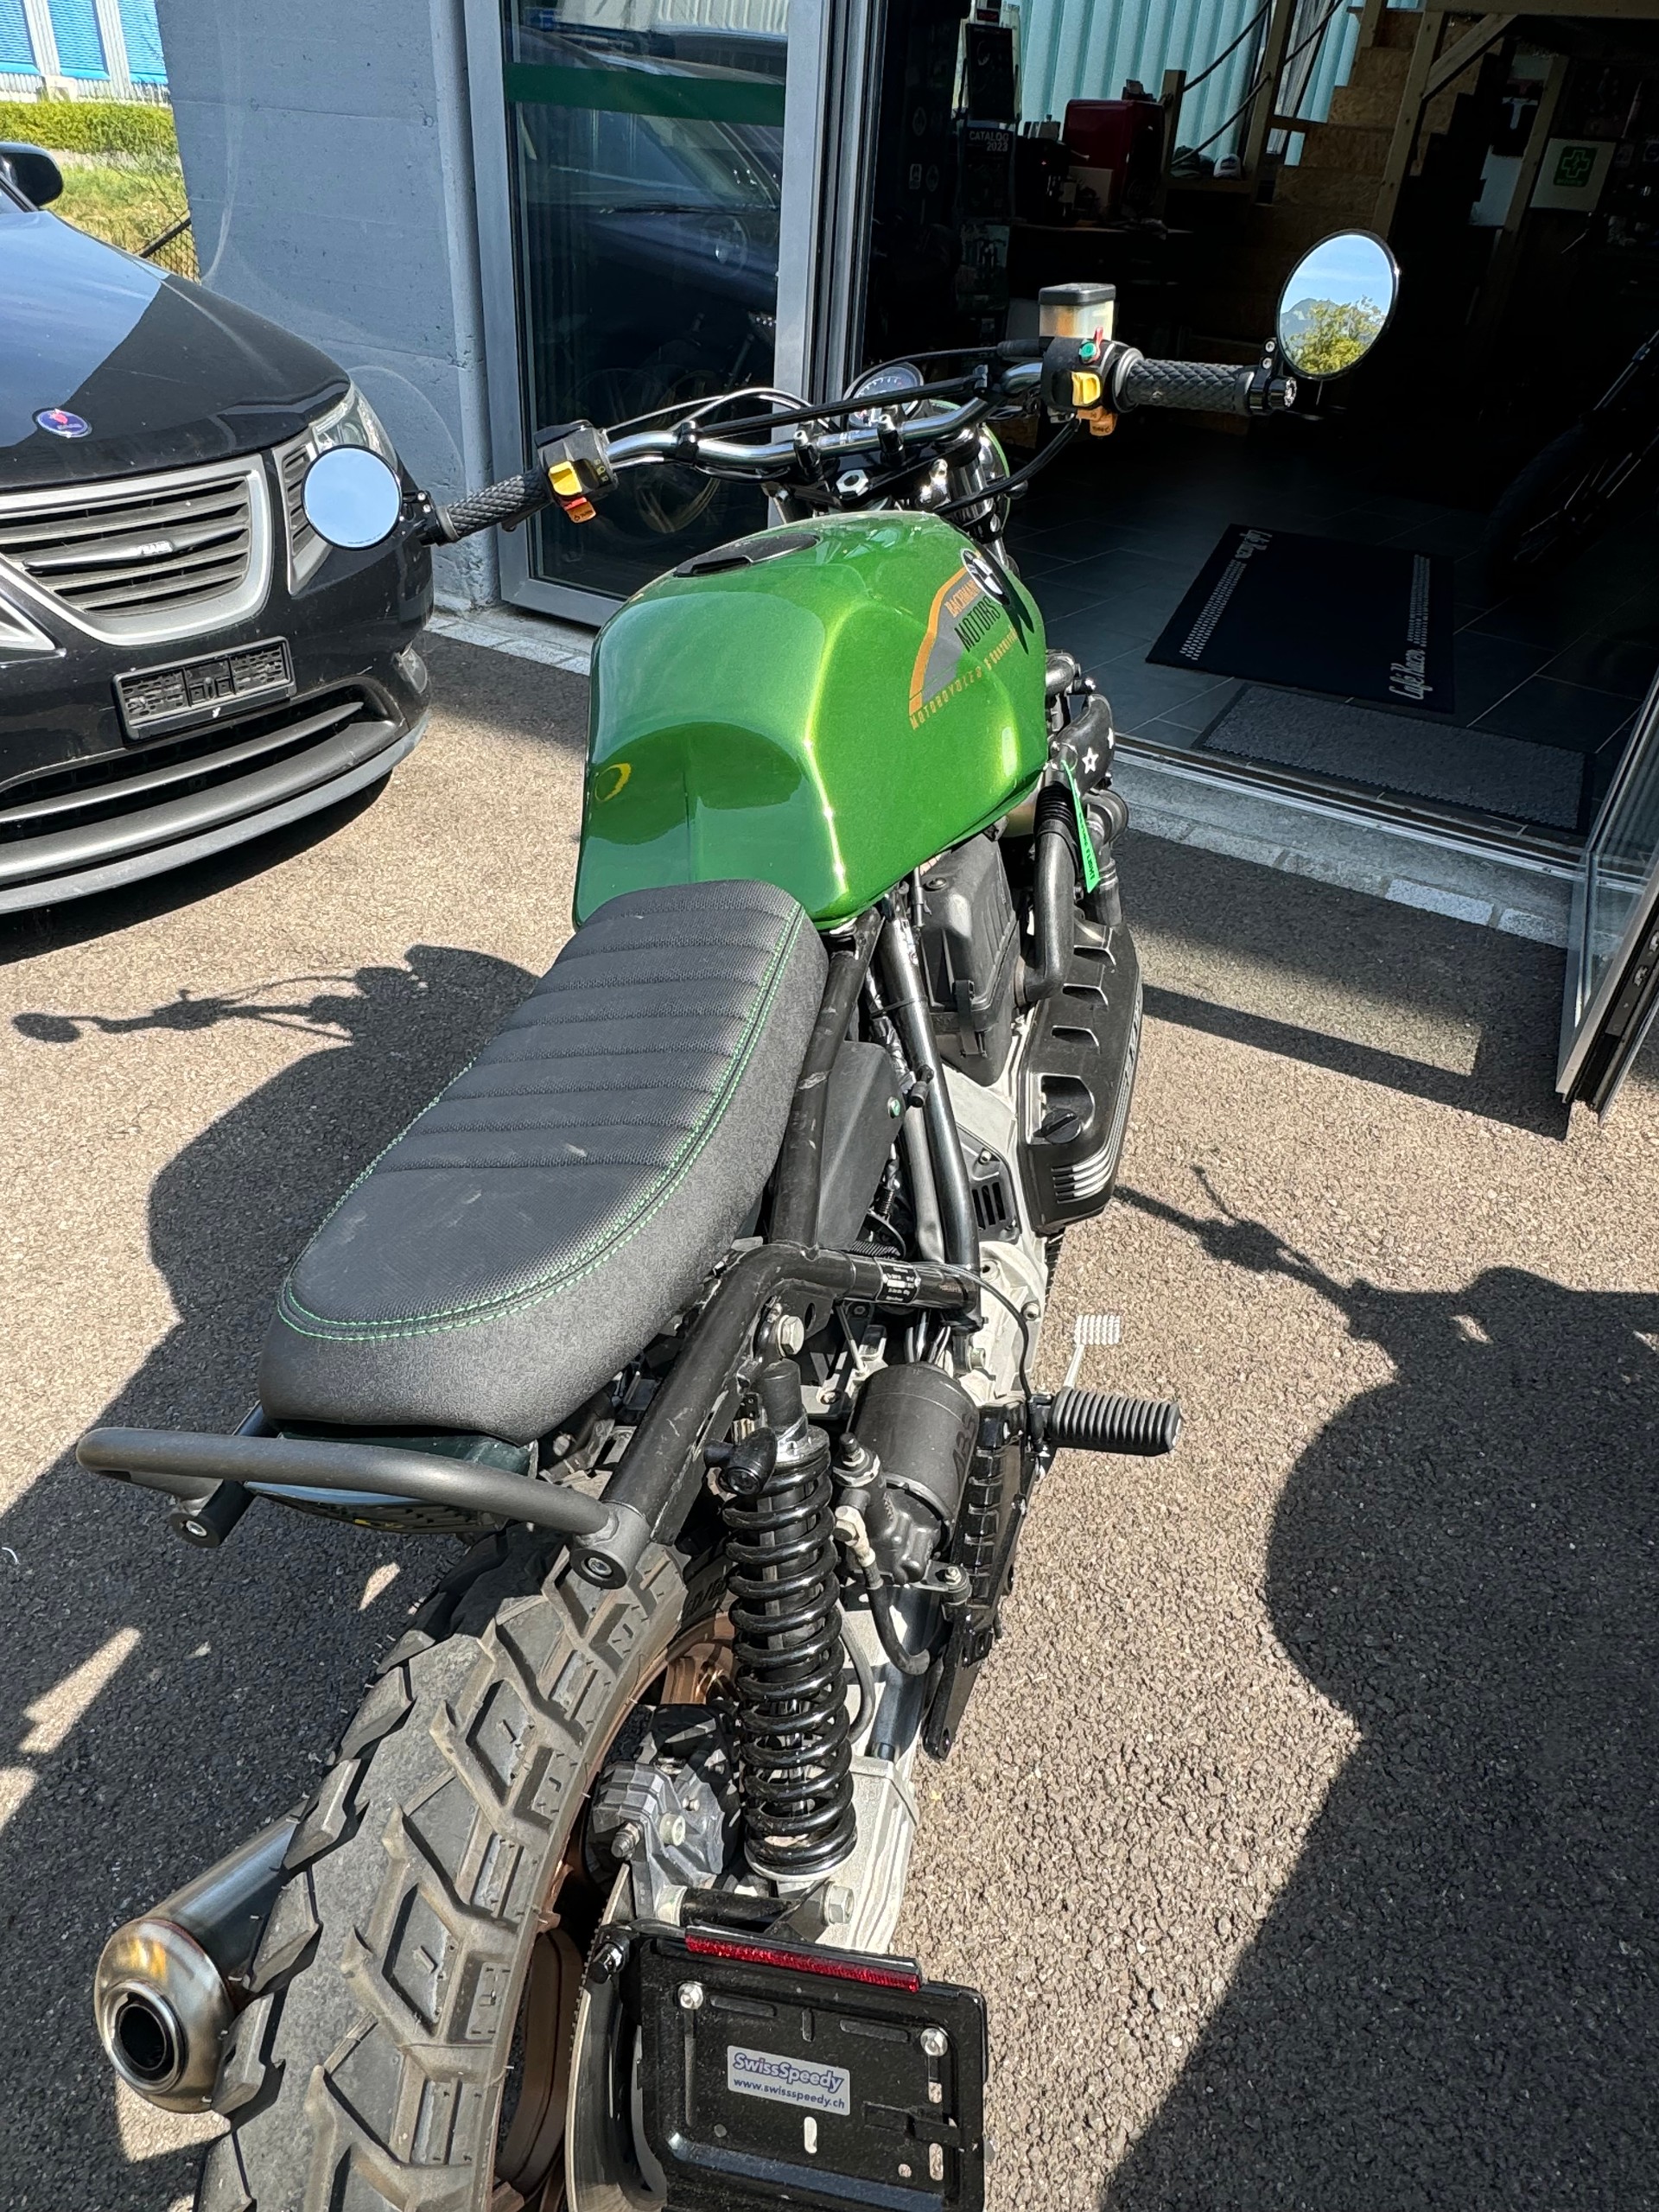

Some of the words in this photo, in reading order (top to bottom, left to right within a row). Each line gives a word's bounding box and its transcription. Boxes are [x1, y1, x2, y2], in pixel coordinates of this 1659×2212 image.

[969, 130, 1009, 142] CATALOG
[987, 141, 1008, 151] 2023
[954, 595, 1001, 653] MOTORS
[733, 2052, 844, 2094] SwissSpeedy
[734, 2078, 845, 2109] www.swissspeedy.ch
